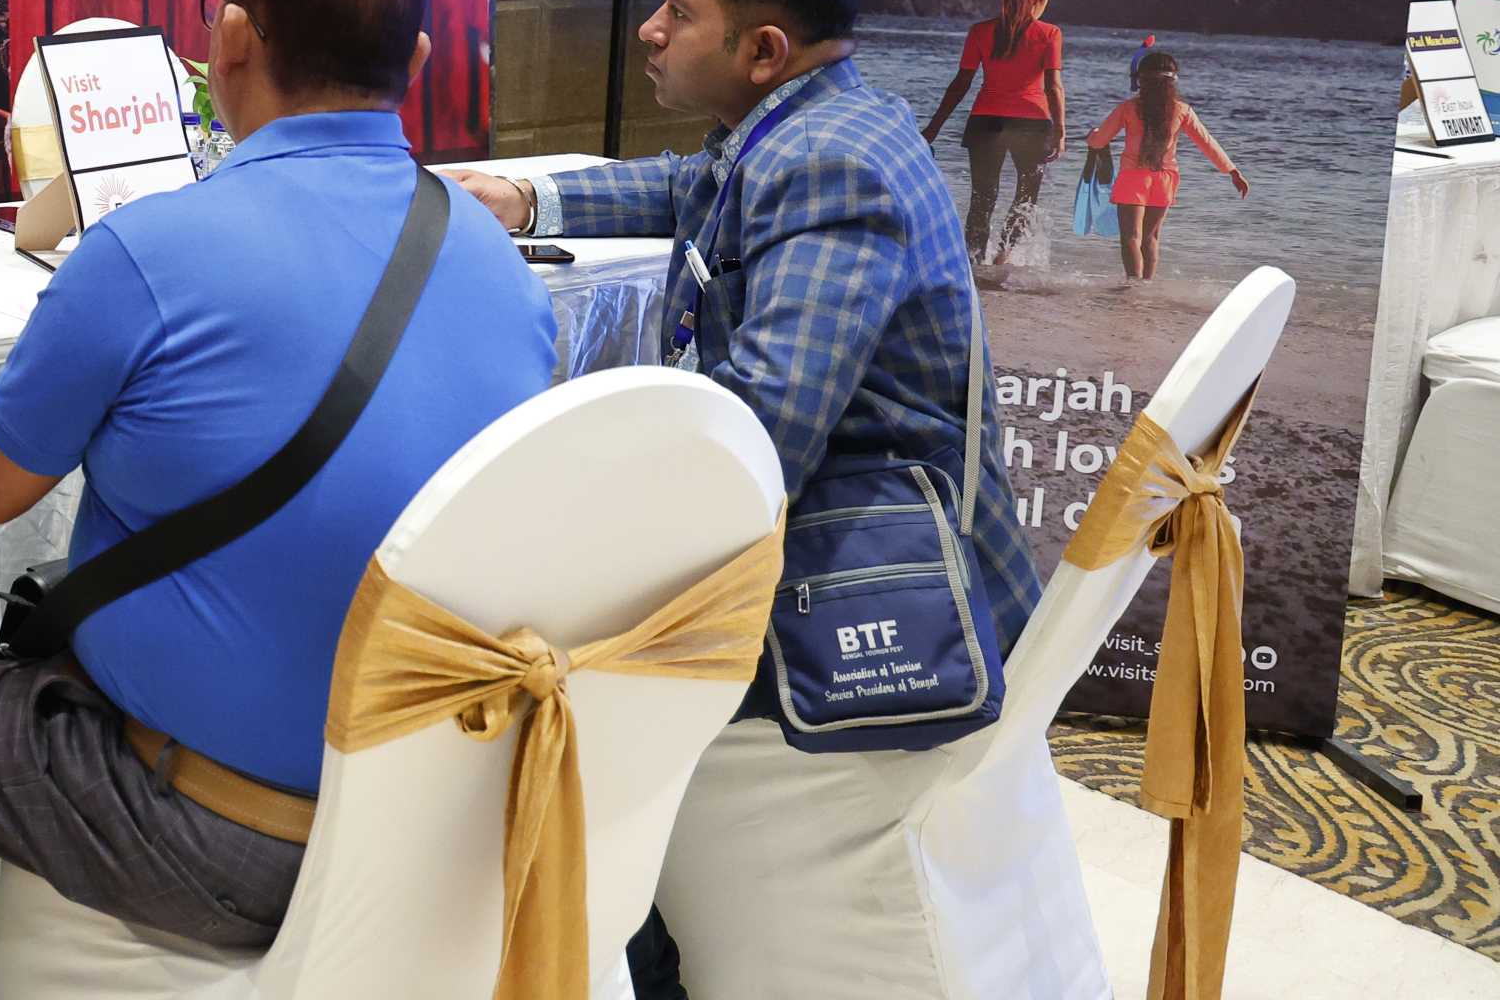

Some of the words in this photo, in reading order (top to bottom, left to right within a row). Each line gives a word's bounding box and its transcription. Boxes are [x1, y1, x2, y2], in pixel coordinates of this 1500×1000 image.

[61, 73, 102, 93] Visit
[69, 92, 173, 135] Sharjah
[996, 367, 1132, 422] arjah
[836, 620, 898, 654] BTF
[824, 689, 854, 702] Service
[855, 682, 896, 697] Providers
[898, 679, 907, 692] of
[908, 673, 940, 690] Bengal
[833, 667, 878, 684] Association
[880, 664, 889, 677] of
[890, 661, 922, 674] Tourism
